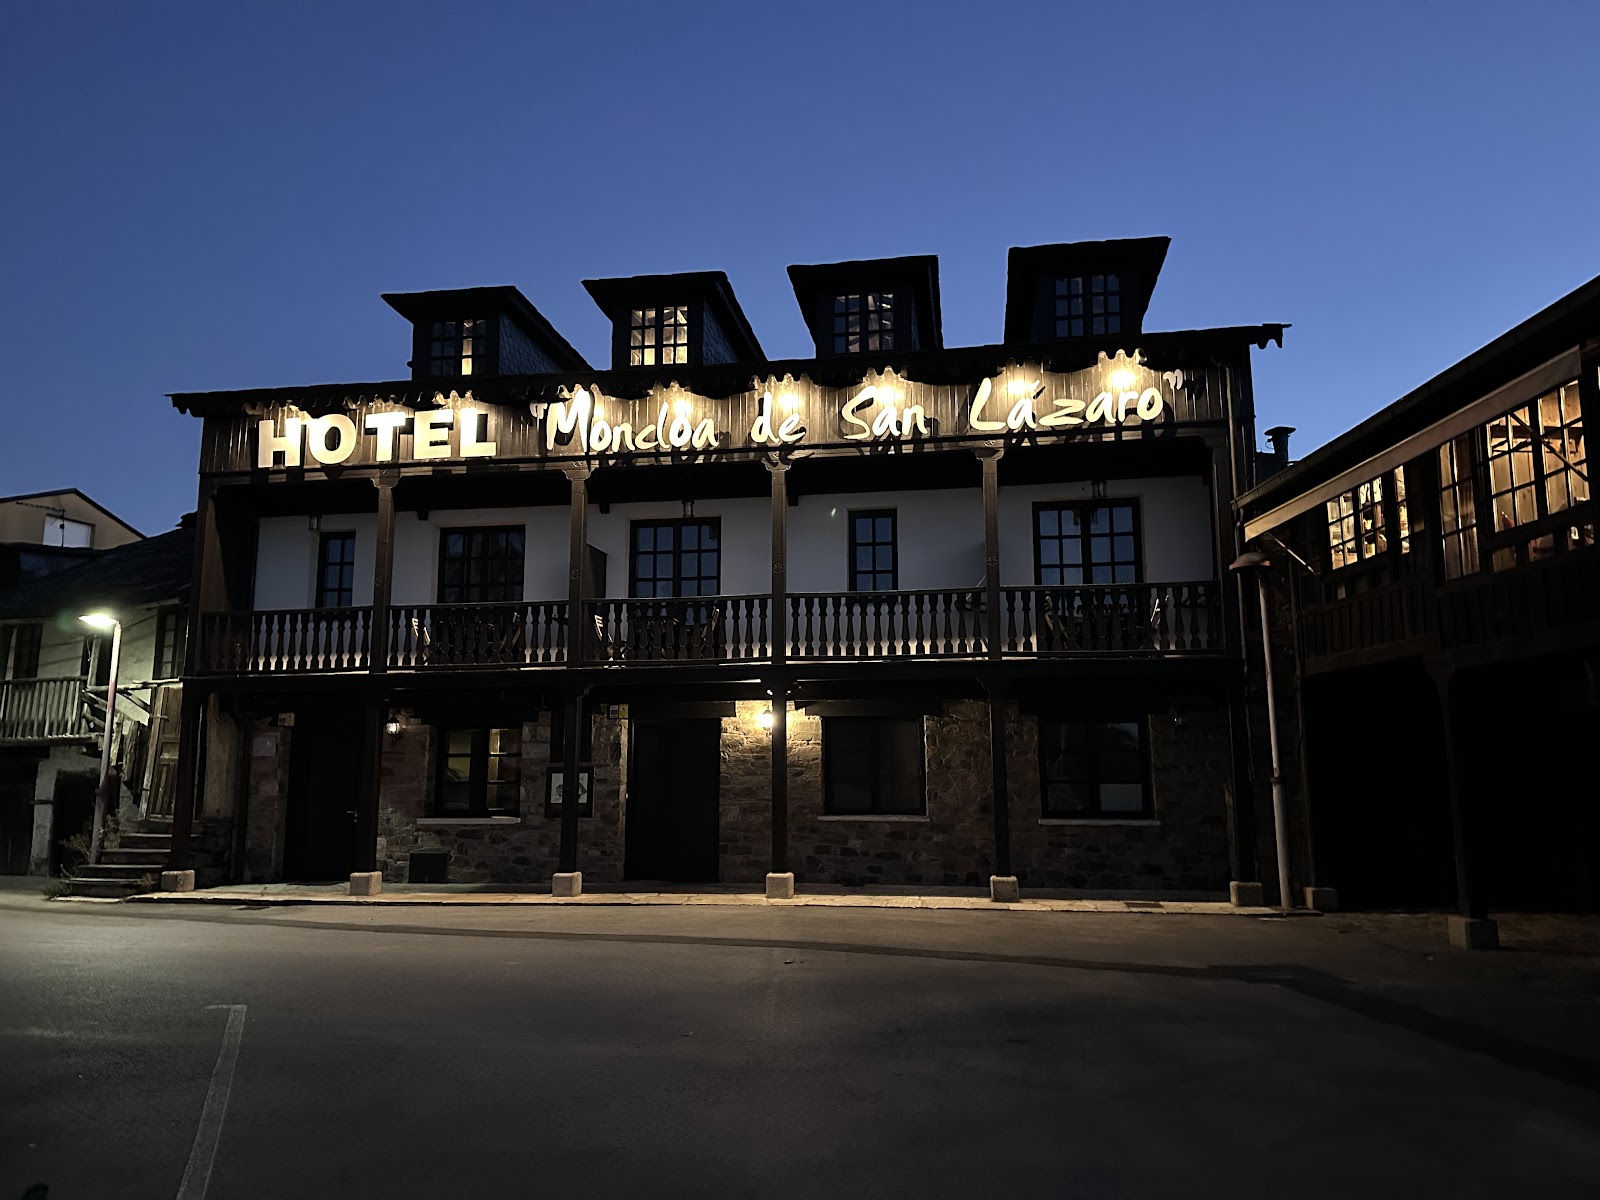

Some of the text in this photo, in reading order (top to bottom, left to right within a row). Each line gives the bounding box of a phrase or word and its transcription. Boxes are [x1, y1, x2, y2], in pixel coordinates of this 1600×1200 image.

[258, 408, 497, 469] HOTEL
[750, 391, 806, 444] de
[841, 385, 929, 440] San
